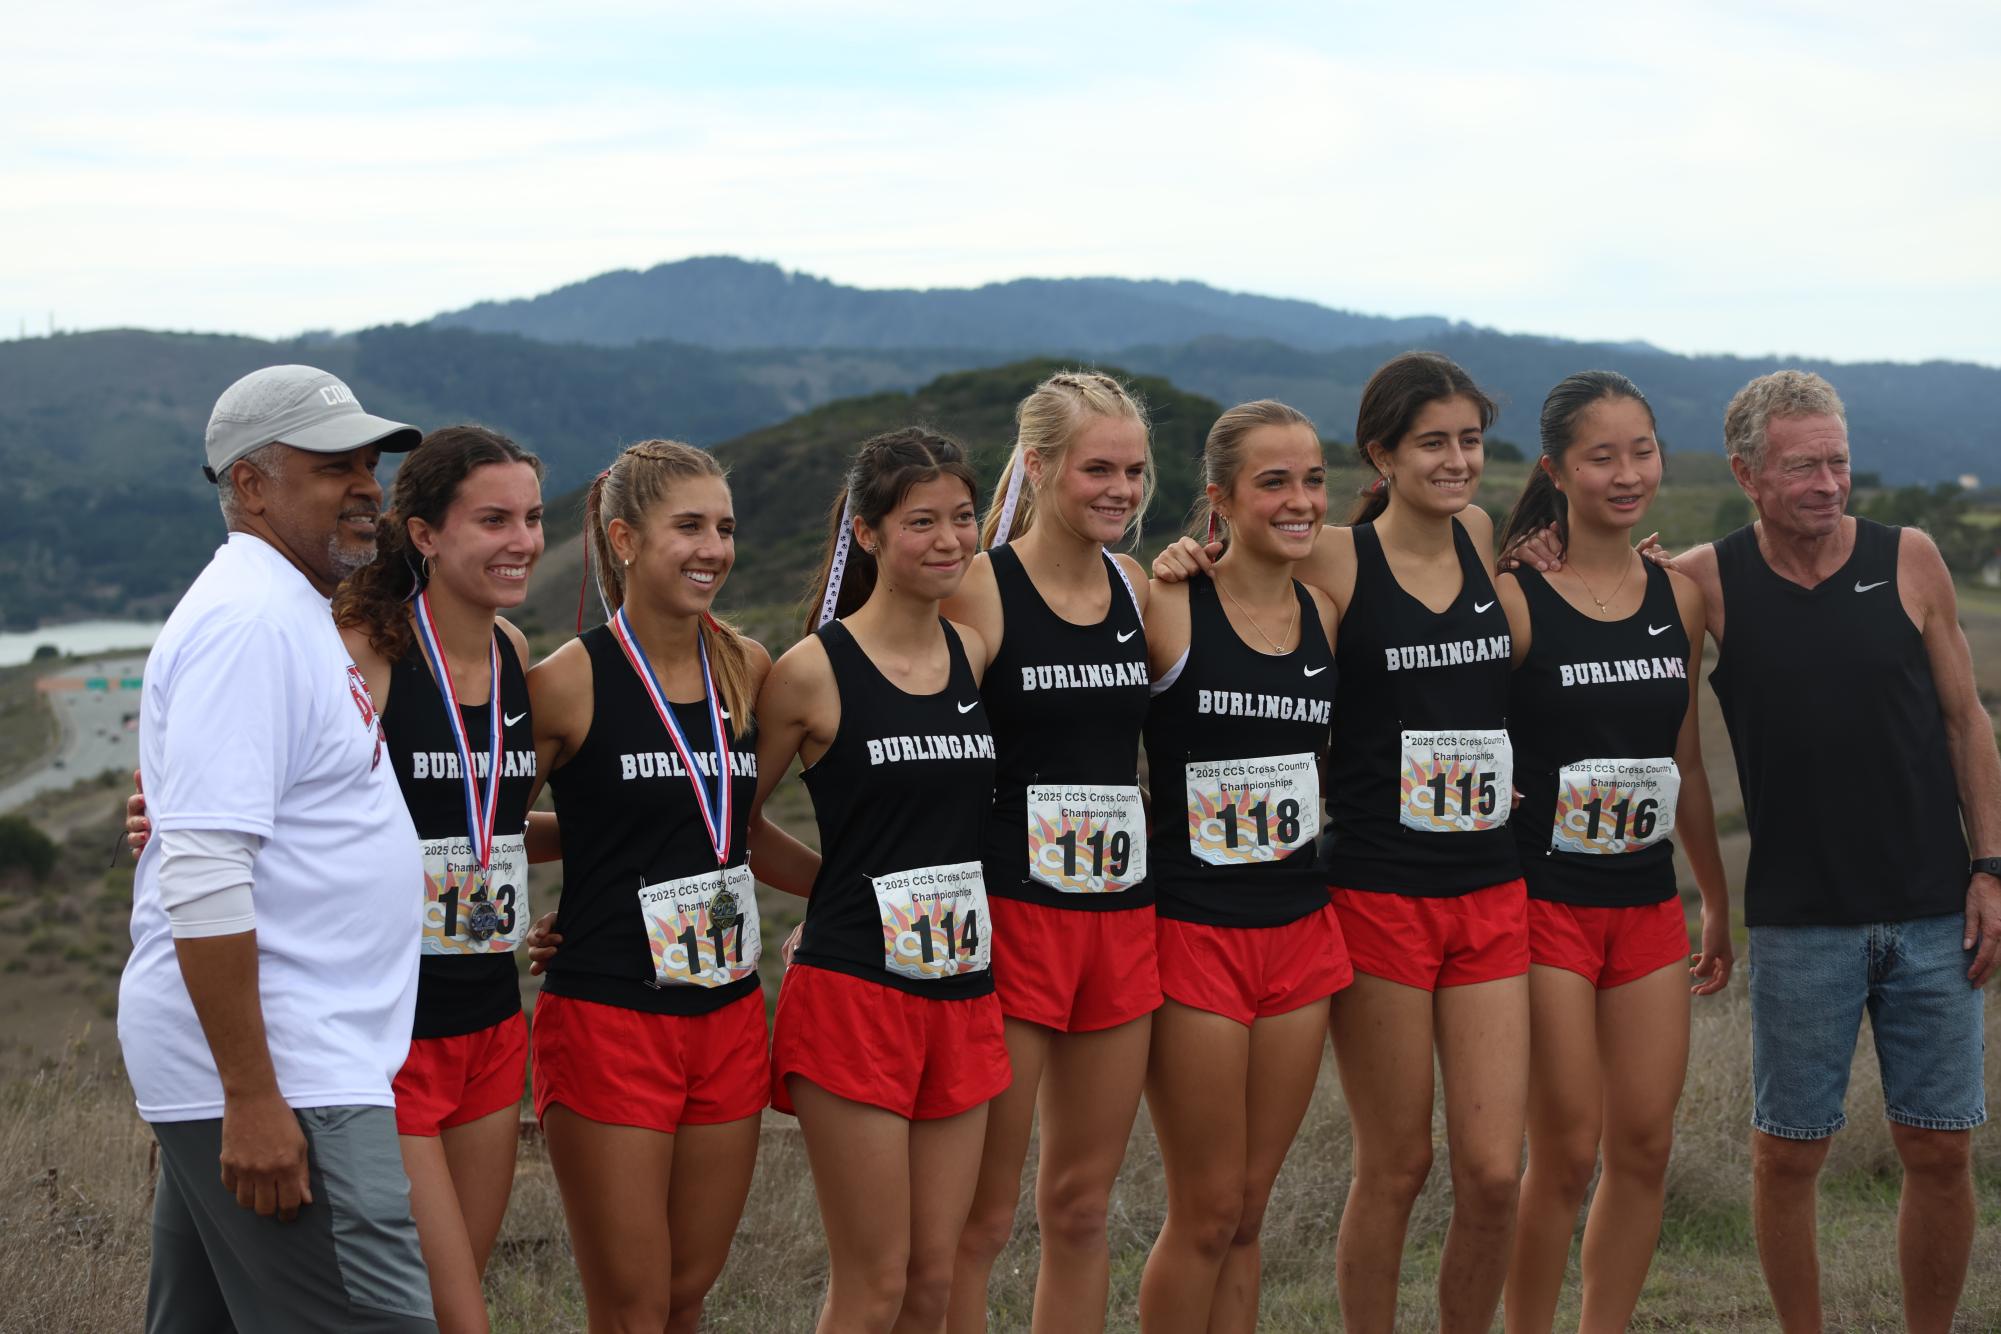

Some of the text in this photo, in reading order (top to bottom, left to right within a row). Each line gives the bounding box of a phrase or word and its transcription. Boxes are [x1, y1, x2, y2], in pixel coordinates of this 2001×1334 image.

[1385, 636, 1510, 671] BURLINGAME
[1022, 662, 1148, 691] BURLINGAME
[1560, 657, 1686, 686] BURLINGAME
[1198, 690, 1331, 724] BURLINGAME
[1412, 737, 1434, 746] 2025
[1436, 737, 1457, 746] CCS
[1460, 738, 1482, 746] Cross
[1433, 752, 1494, 762] Championships
[1196, 769, 1220, 778] 2025
[1223, 766, 1244, 776] CCS
[1248, 764, 1275, 774] Cross
[1278, 762, 1310, 772] Country
[1569, 764, 1592, 772] 2025
[1594, 764, 1615, 773] CCS
[1618, 765, 1644, 774] Cross
[1220, 778, 1293, 792] Championships
[1591, 778, 1657, 789] Championships
[1037, 792, 1062, 802] 2025
[1064, 792, 1086, 802] CCS
[1090, 793, 1114, 802] Cross
[1427, 772, 1496, 816] 115
[1062, 808, 1126, 820] Championships
[1216, 798, 1300, 848] 118
[1583, 798, 1658, 840] 116
[424, 846, 448, 856] 2025
[451, 844, 472, 855] CCS
[1056, 830, 1130, 876] 119
[884, 878, 910, 890] 2025
[912, 876, 934, 886] CCS
[938, 872, 960, 883] Cross
[650, 889, 676, 902] 2025
[678, 884, 699, 896] CCS
[912, 888, 972, 902] Championships
[911, 910, 978, 964] 114
